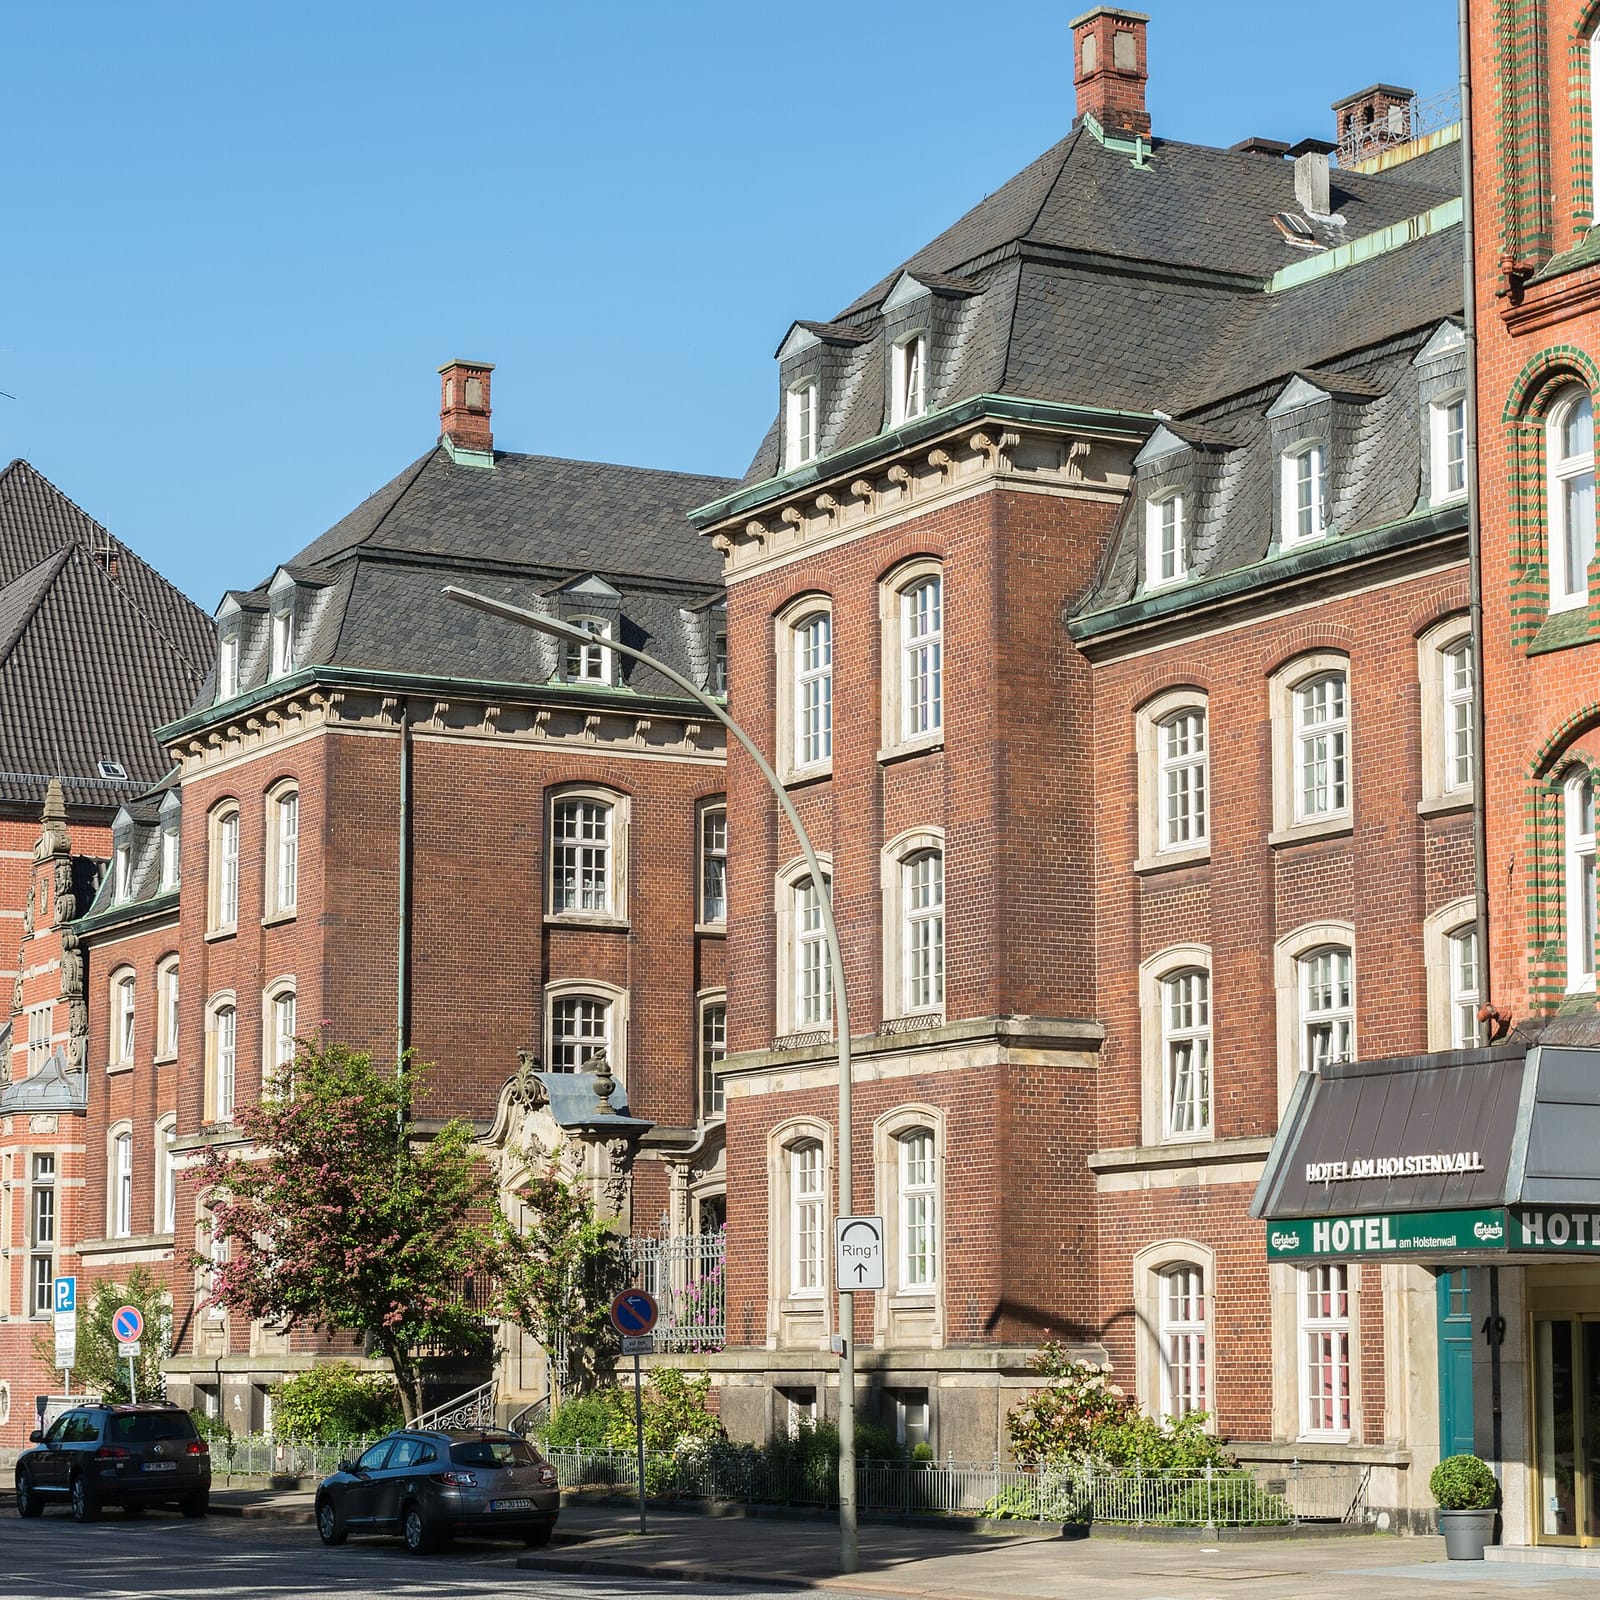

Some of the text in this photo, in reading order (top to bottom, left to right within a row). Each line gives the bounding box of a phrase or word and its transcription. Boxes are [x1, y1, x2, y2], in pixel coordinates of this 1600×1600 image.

[1306, 1151, 1484, 1181] HOTEL AM HOLSTENWALL
[1271, 1230, 1300, 1251] Carlsberg
[1313, 1218, 1456, 1252] HOTEL am Holstenwall
[1474, 1221, 1503, 1241] Carlsberg
[57, 1281, 70, 1309] P
